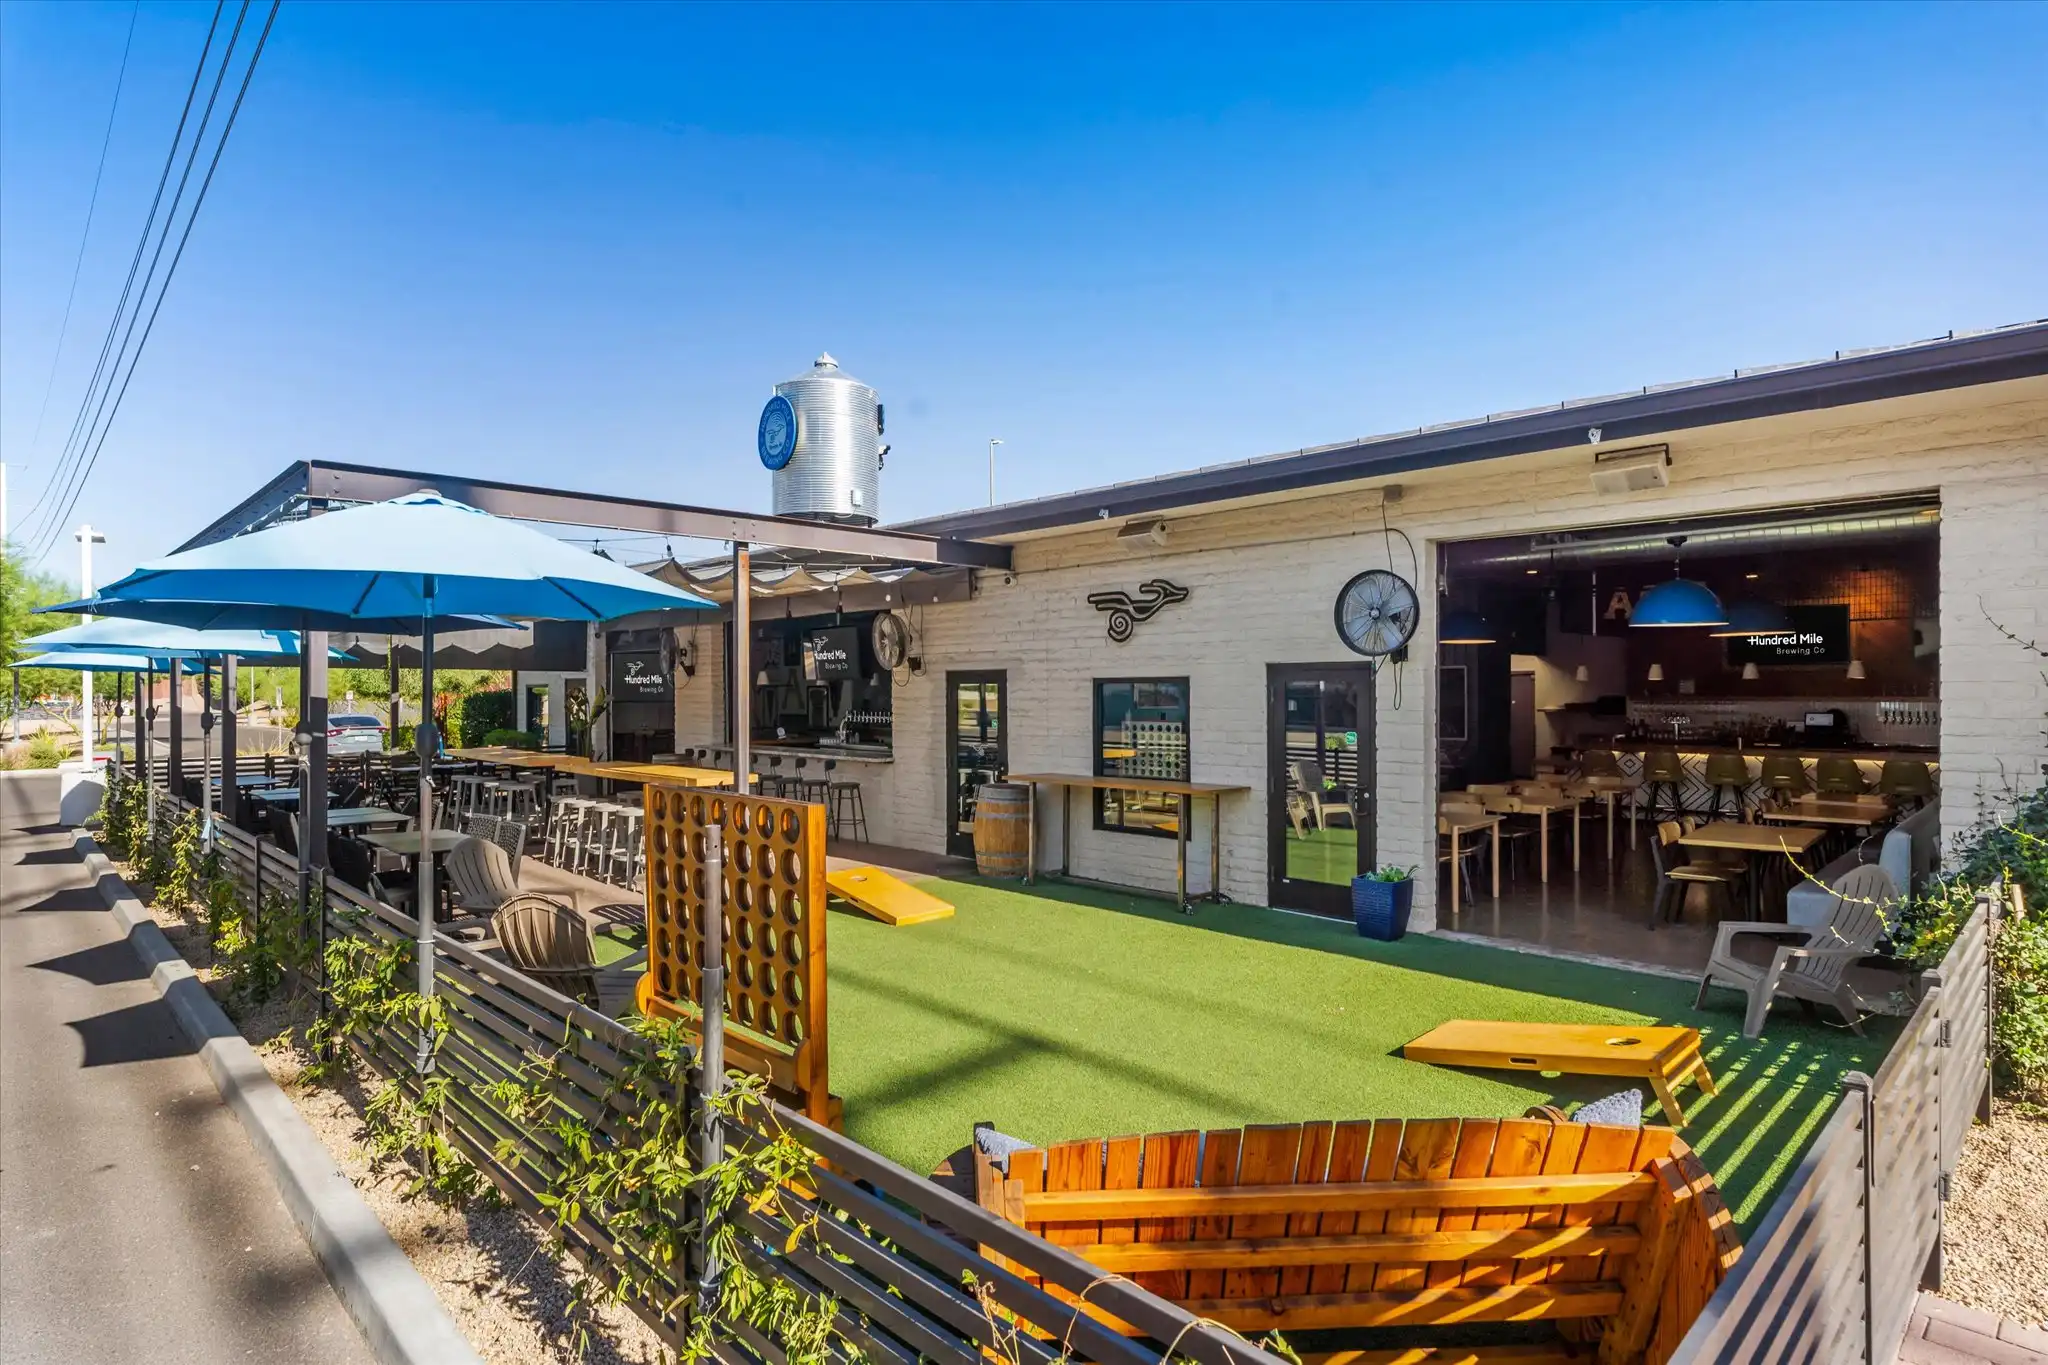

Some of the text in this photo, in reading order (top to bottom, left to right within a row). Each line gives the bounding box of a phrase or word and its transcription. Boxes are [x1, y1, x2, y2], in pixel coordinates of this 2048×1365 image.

[1746, 633, 1824, 646] Hundred Mile
[835, 650, 846, 660] Mile
[1776, 646, 1826, 656] Brewing Co
[624, 674, 662, 684] Hundred Mile
